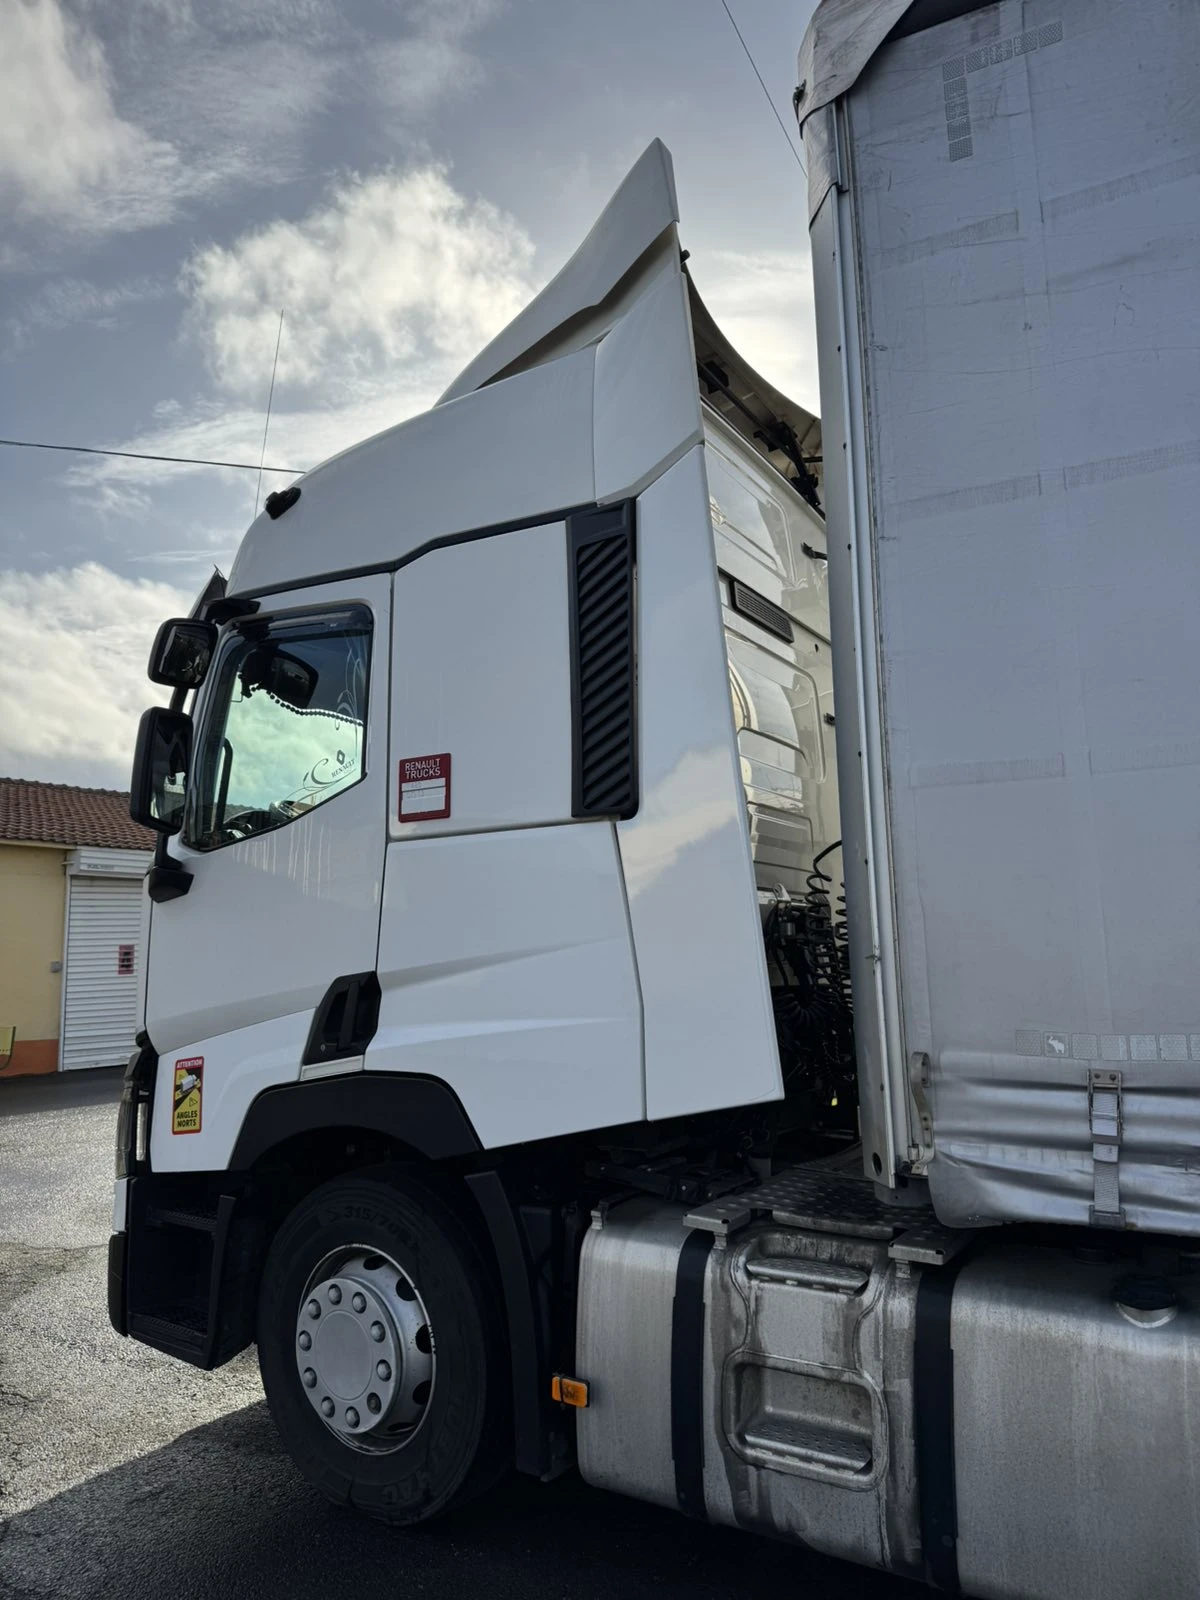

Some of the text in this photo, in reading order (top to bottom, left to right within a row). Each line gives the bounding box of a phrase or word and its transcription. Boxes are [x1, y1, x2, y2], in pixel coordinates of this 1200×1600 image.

[331, 758, 356, 778] RENAULT
[405, 759, 441, 771] RENAULT
[406, 767, 441, 779] TRUCKS
[177, 1060, 202, 1068] ATTENTION
[177, 1110, 198, 1119] ANGLES
[177, 1119, 197, 1128] MORTS
